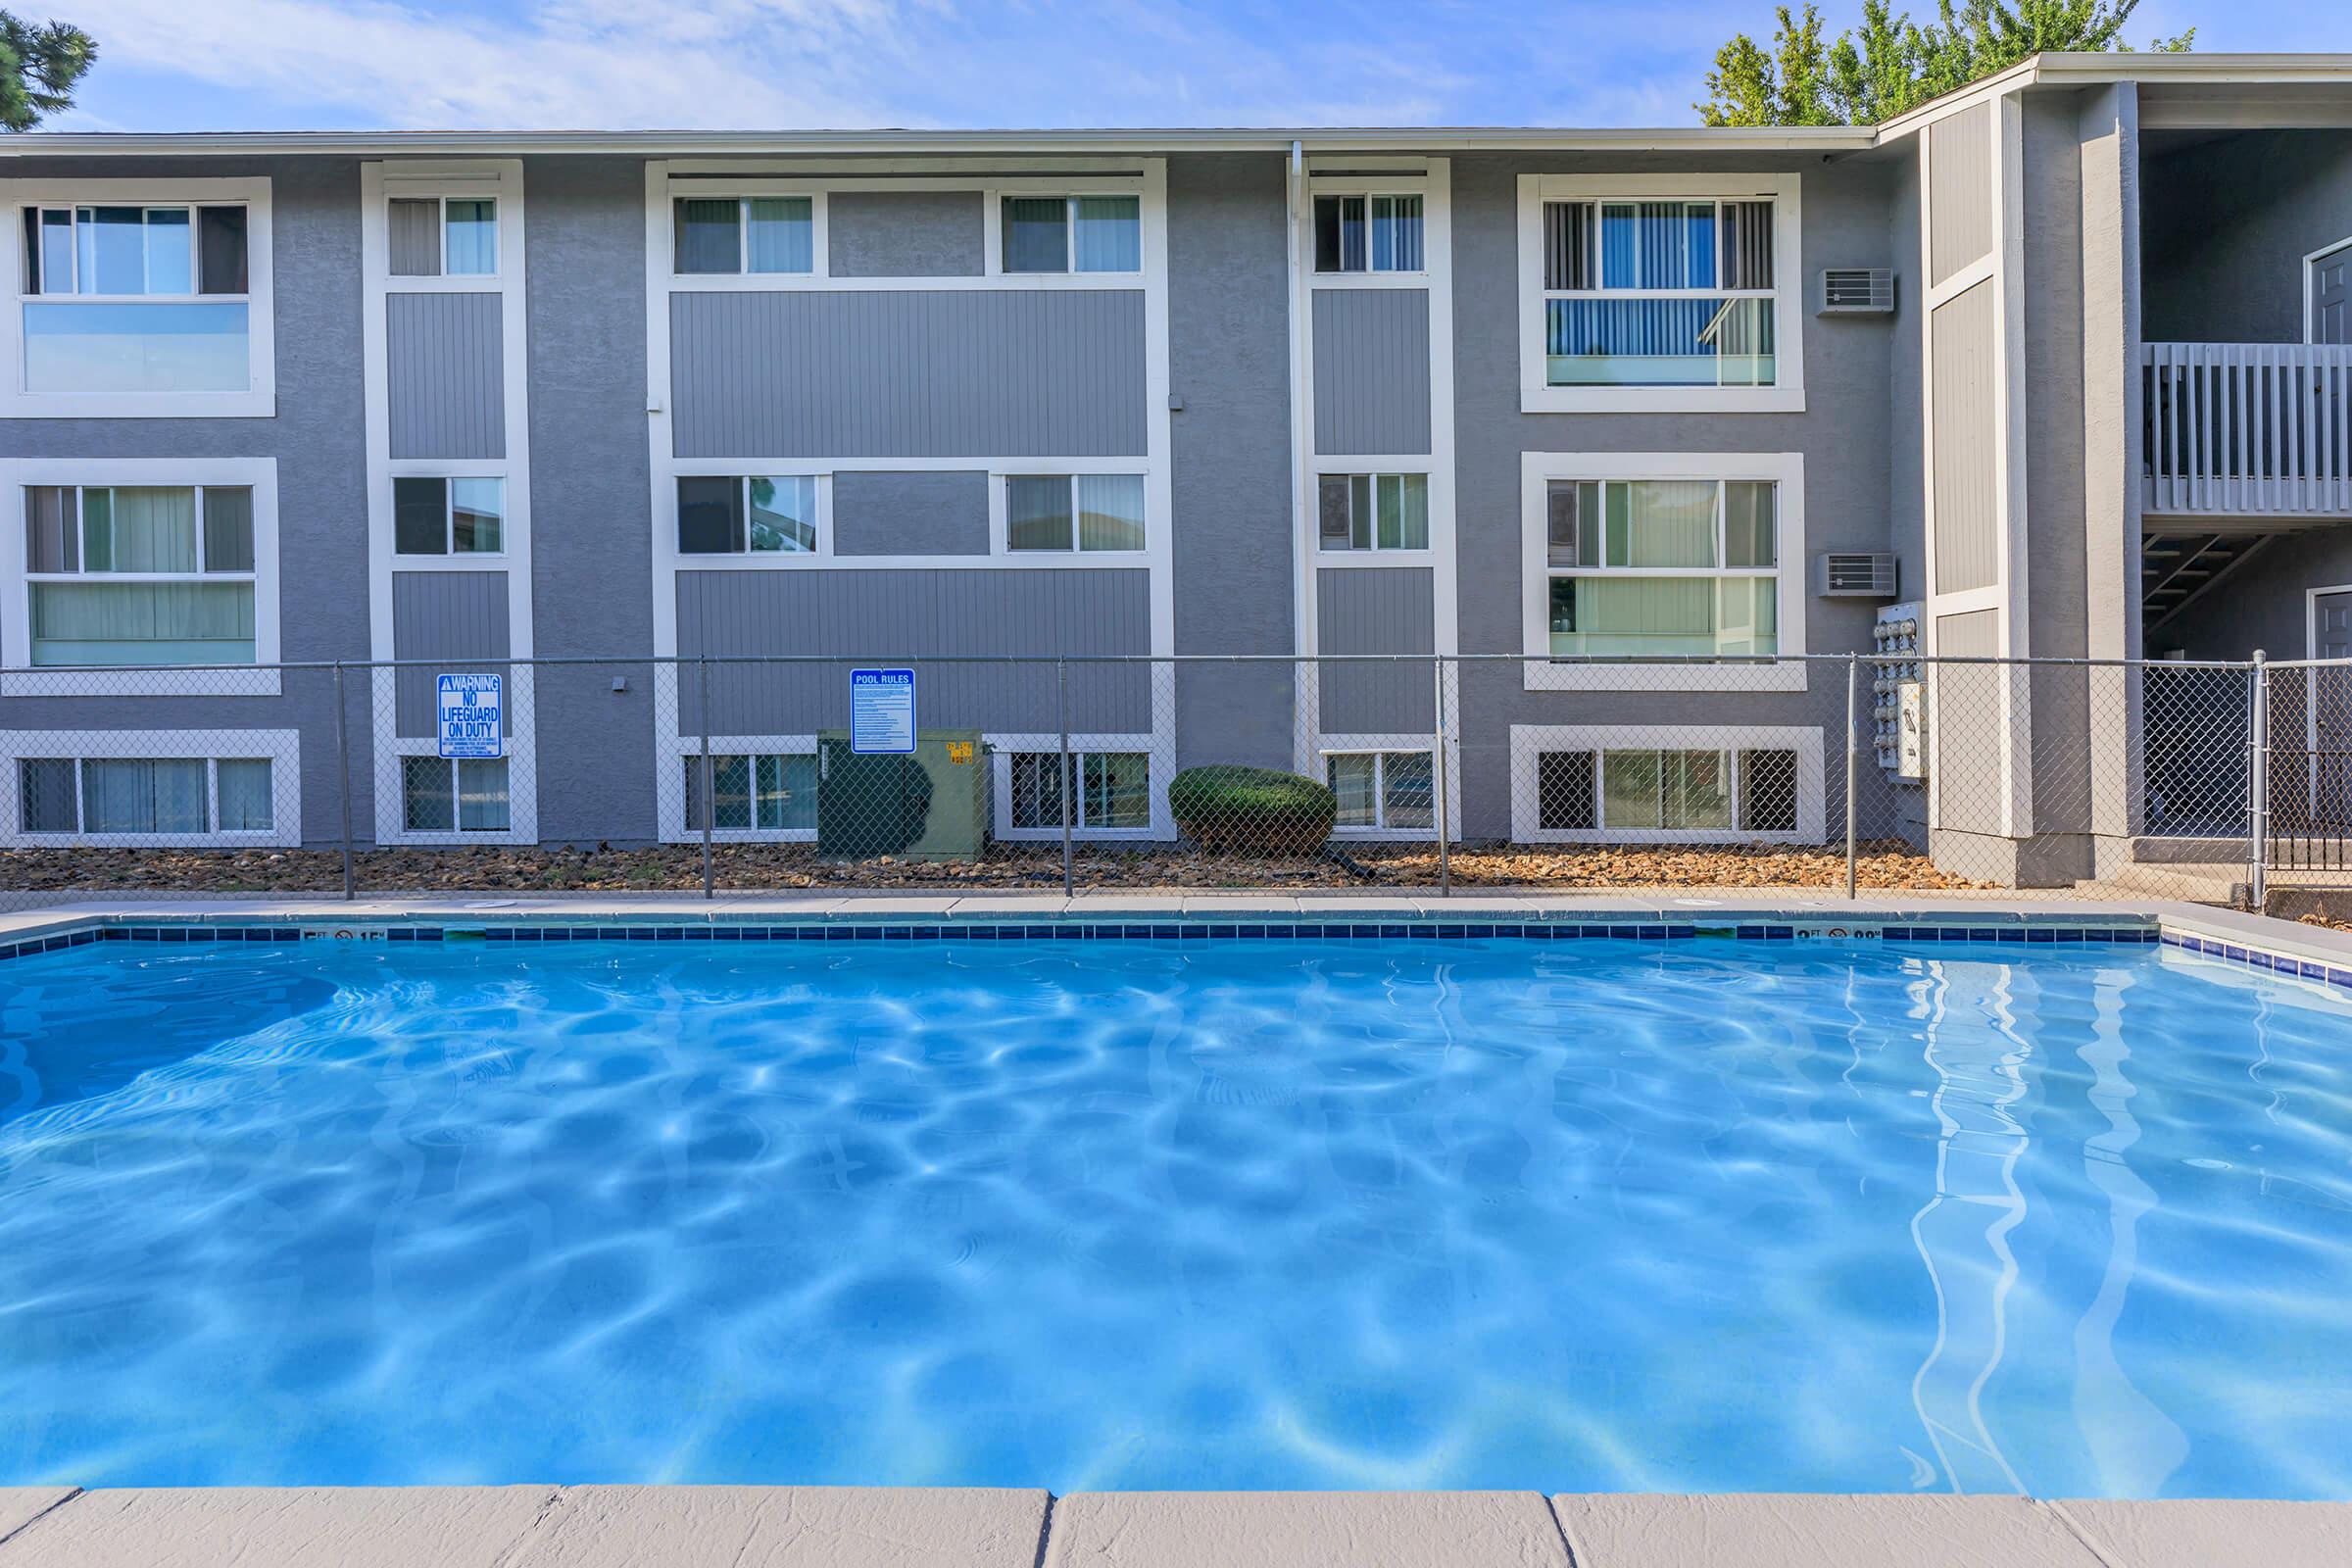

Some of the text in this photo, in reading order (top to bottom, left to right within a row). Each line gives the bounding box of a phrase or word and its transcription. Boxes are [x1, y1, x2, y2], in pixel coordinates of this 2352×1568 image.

[452, 676, 498, 690] WARNING
[463, 692, 477, 706] NO
[443, 707, 497, 721] LIFEGUARD
[449, 722, 492, 737] ON DUTY
